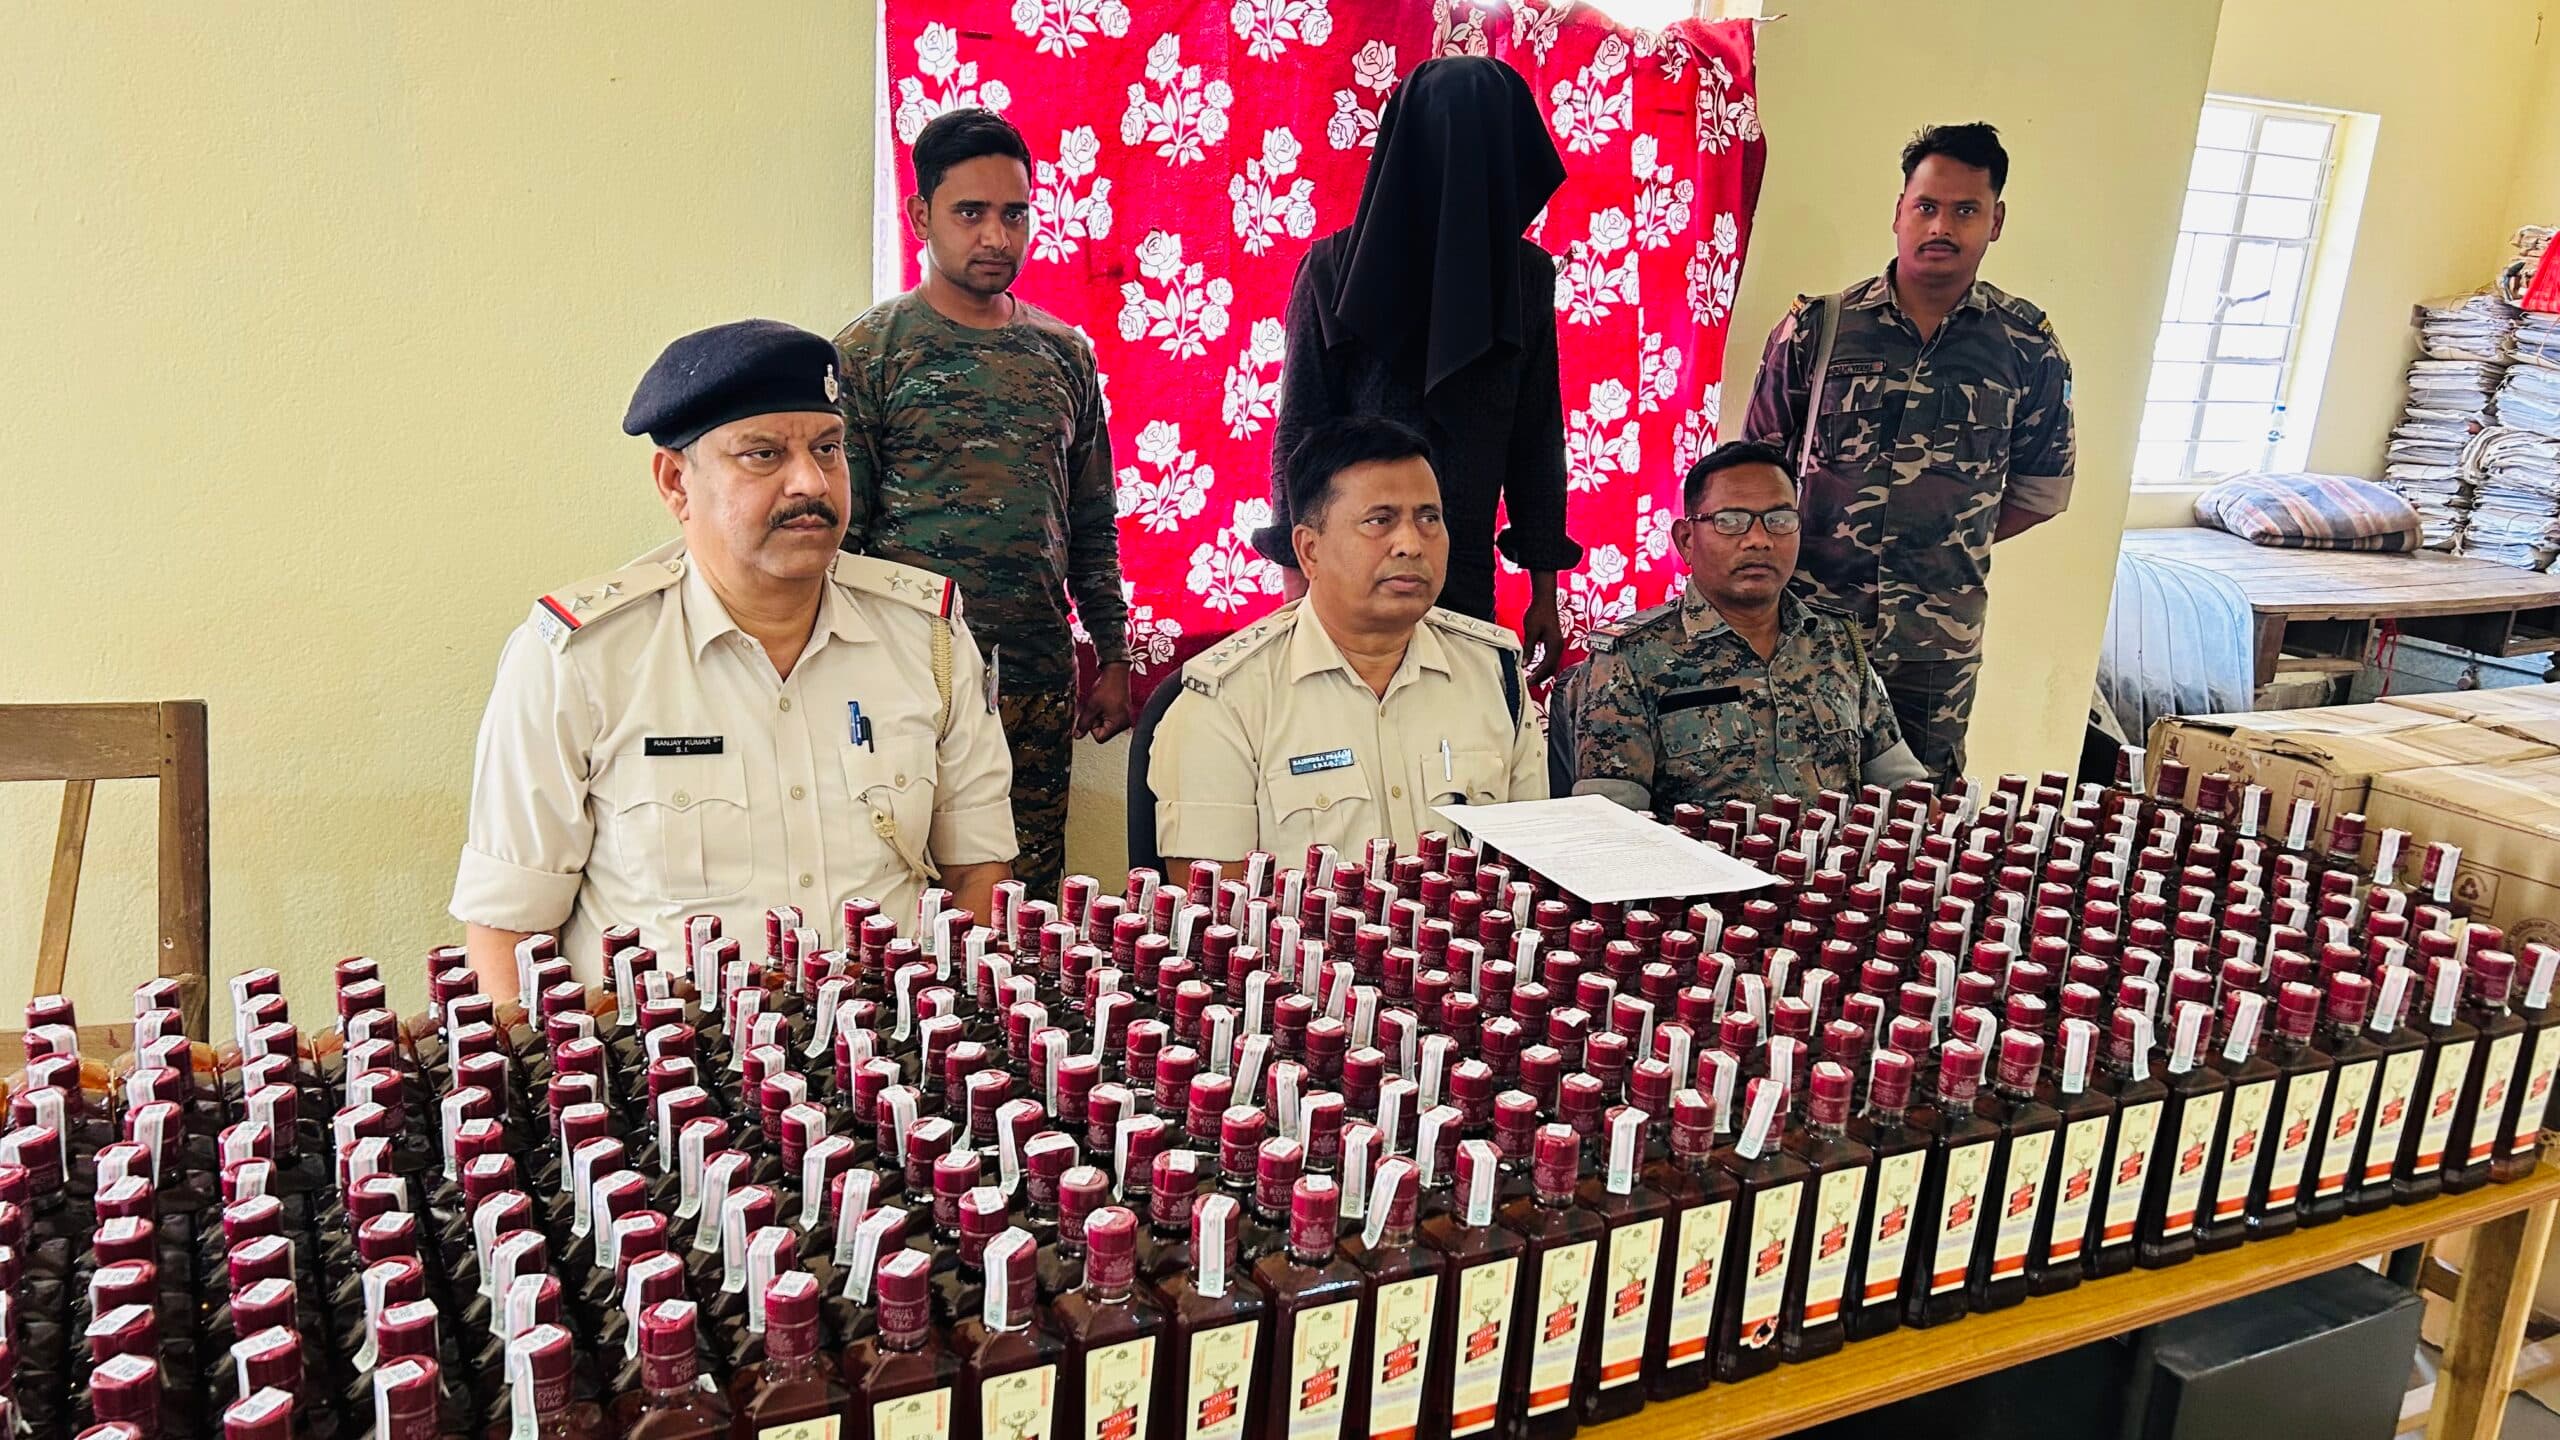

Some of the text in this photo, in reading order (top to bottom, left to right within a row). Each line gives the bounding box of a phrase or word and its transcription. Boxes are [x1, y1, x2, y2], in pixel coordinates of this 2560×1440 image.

[684, 738, 711, 746] KUMAR
[1470, 1323, 1497, 1344] ROYAL
[1387, 1343, 1417, 1363] ROYAL
[1305, 1369, 1336, 1390] ROYAL
[1387, 1360, 1413, 1379] STAG
[1202, 1389, 1235, 1410] ROYAL
[1306, 1386, 1332, 1406] STAG
[1101, 1408, 1135, 1431] ROYAL
[1204, 1406, 1231, 1425] STAG
